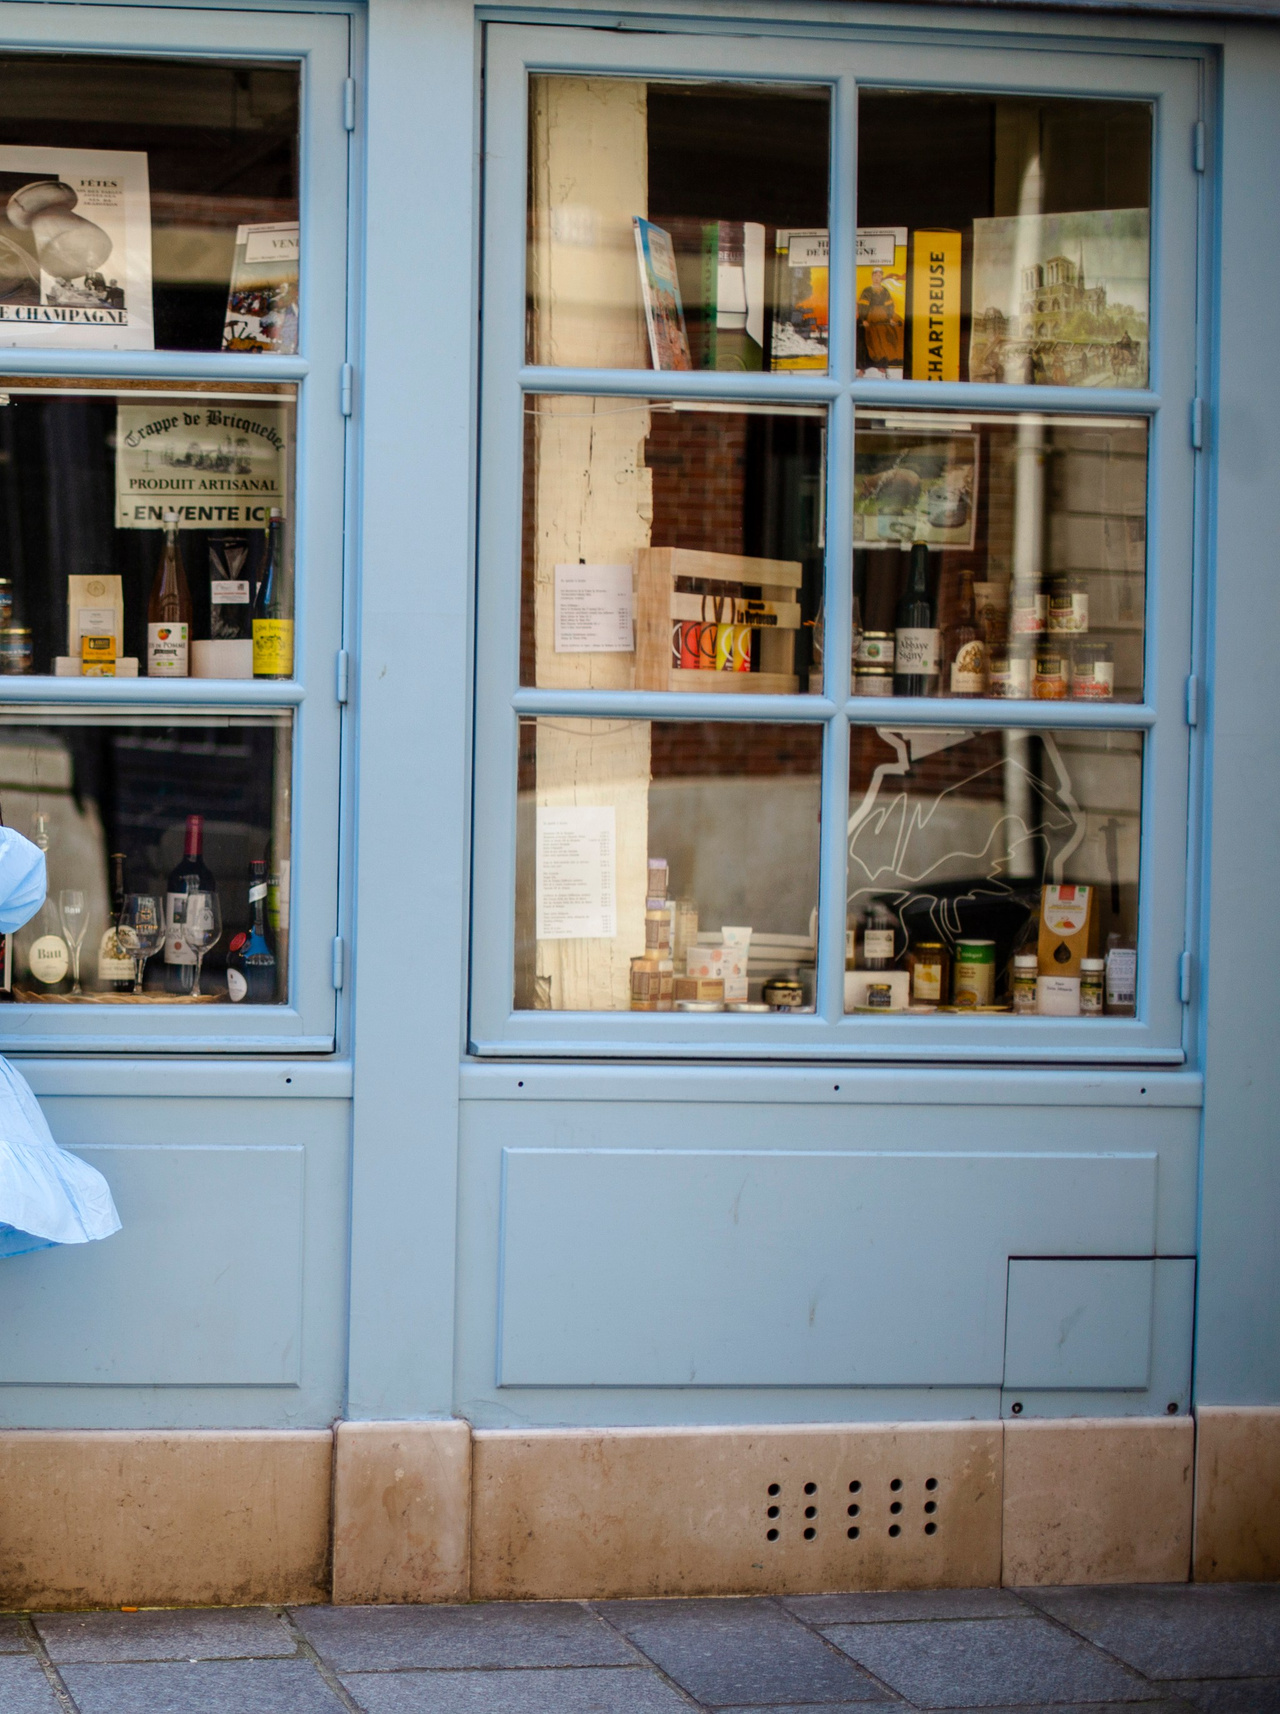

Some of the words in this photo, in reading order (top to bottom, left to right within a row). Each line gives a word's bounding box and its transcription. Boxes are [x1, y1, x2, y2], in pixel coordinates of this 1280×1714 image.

[81, 178, 117, 187] FÊTES
[15, 306, 128, 324] CHAMPAGNE
[124, 417, 179, 448] Trappe
[183, 412, 201, 426] de
[129, 478, 196, 490] PRODUIT
[198, 479, 279, 491] ARTISANAL
[134, 505, 163, 520] EN
[245, 506, 266, 521] IC
